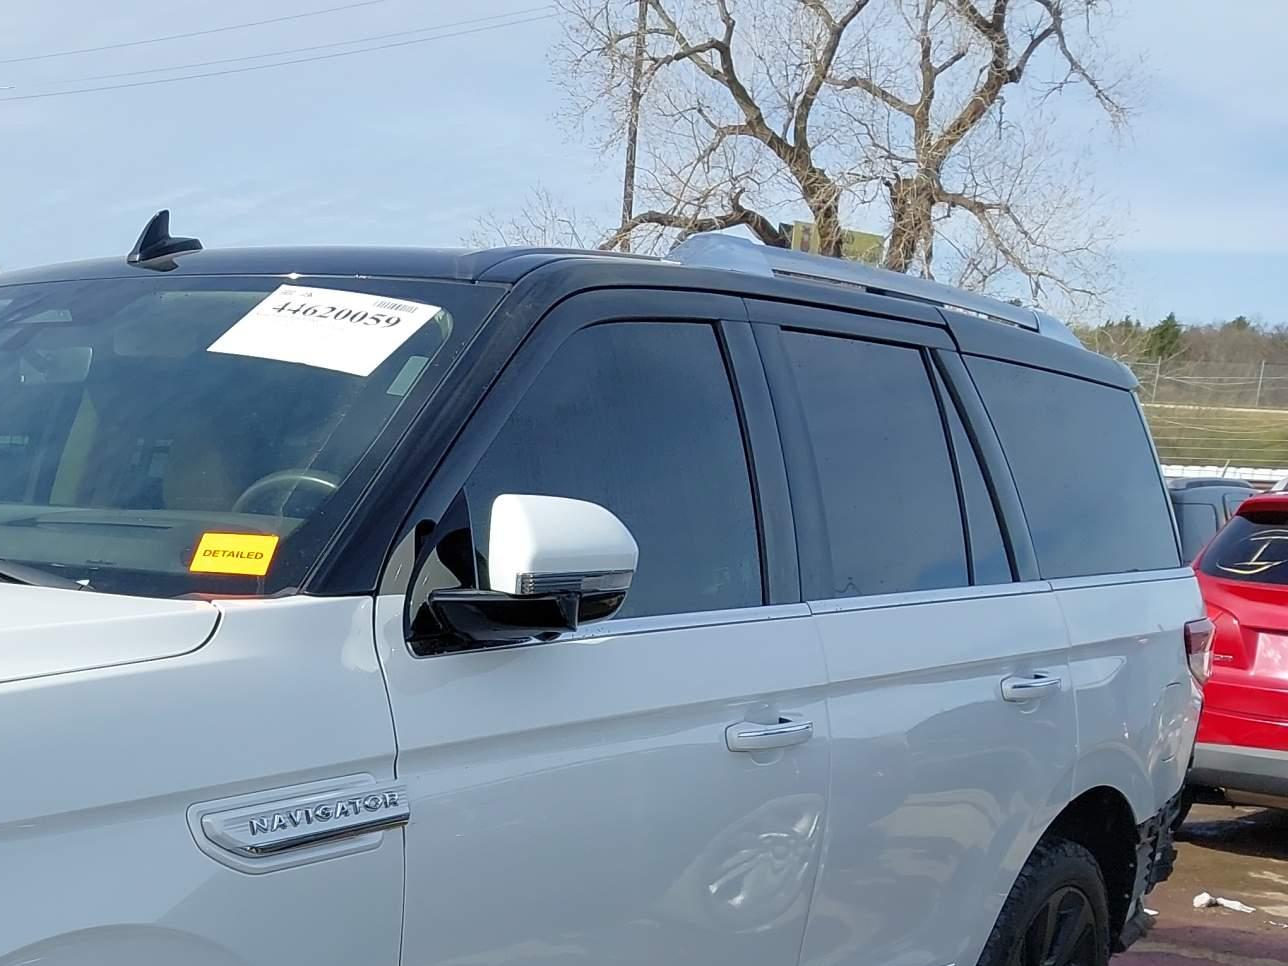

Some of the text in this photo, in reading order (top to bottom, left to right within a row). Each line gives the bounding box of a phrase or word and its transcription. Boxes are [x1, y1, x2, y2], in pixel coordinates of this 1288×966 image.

[272, 301, 401, 328] 44620059
[202, 549, 264, 560] DETAILED
[248, 791, 400, 836] NAVIGATOR
